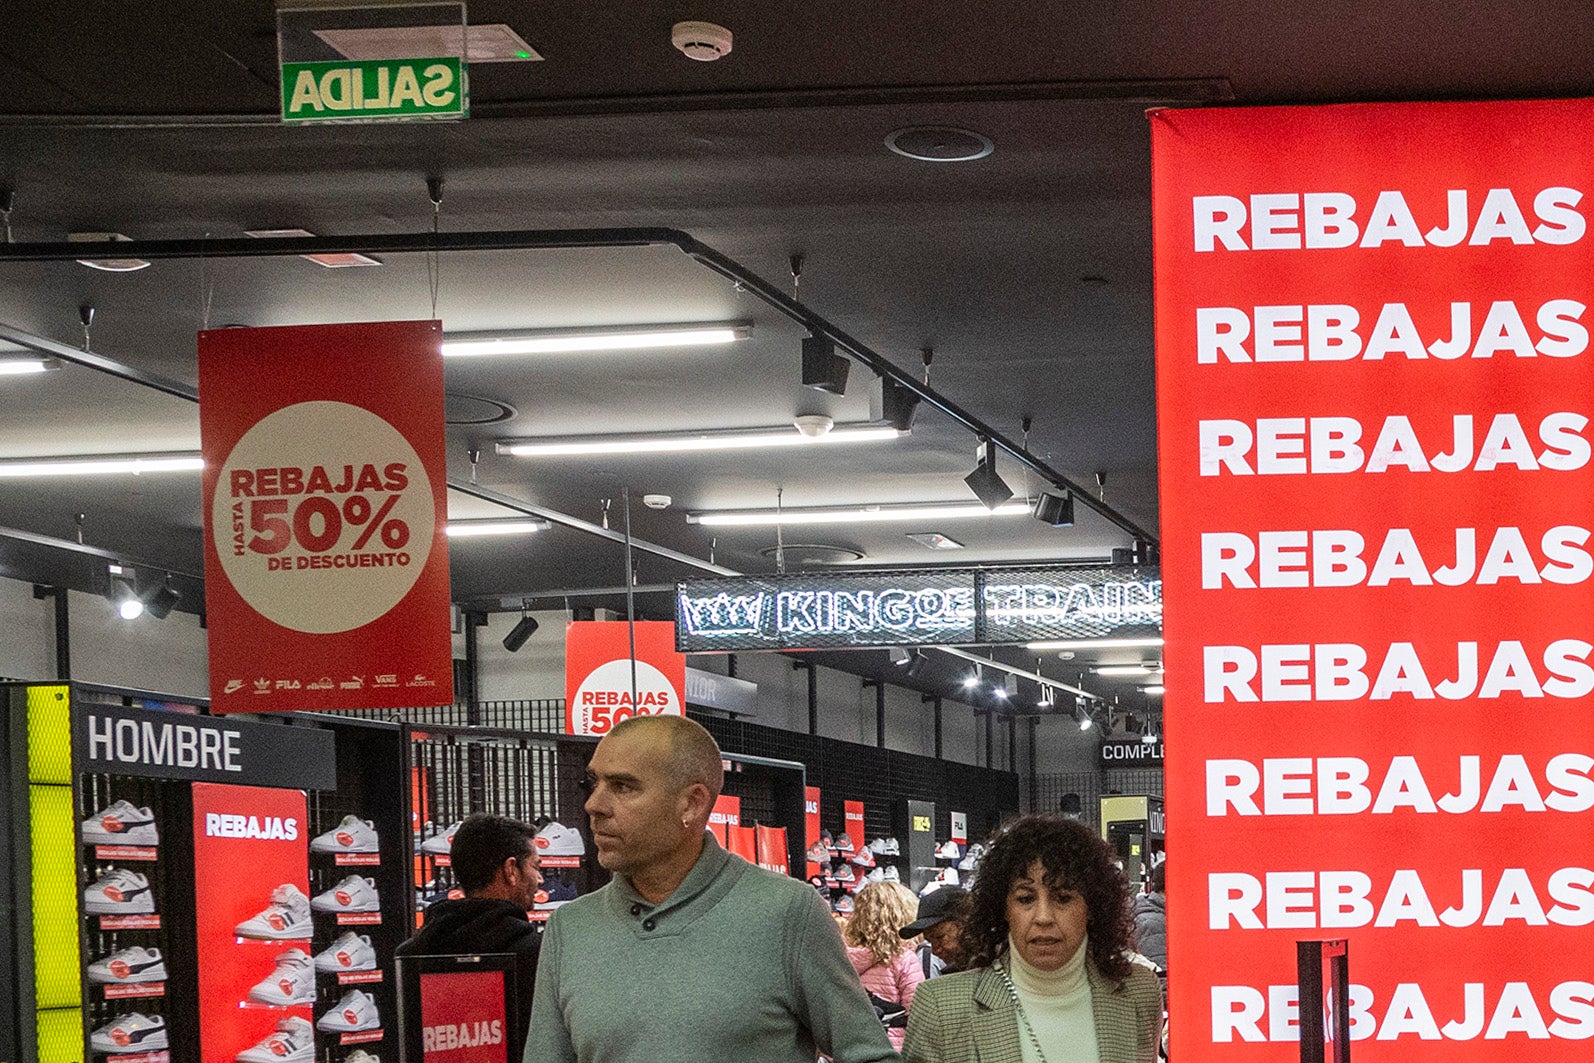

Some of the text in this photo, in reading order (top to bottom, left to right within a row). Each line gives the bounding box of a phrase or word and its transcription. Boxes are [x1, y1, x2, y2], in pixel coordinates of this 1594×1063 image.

[1193, 187, 1586, 252] REBAJAS
[1197, 300, 1588, 363] REBAJAS
[1199, 412, 1591, 476] REBAJAS
[230, 462, 409, 498] REBAJAS
[233, 493, 410, 556] HASTA 50%
[268, 552, 411, 571] DE DESCUENTO
[1202, 526, 1593, 589] REBAJAS
[776, 588, 916, 634] KING
[582, 691, 669, 706] REBAJAS
[1204, 640, 1594, 702] REBAJAS
[88, 714, 242, 772] HOMBRE
[205, 812, 298, 843] REBAJAS
[422, 1019, 503, 1053] REBAJAS
